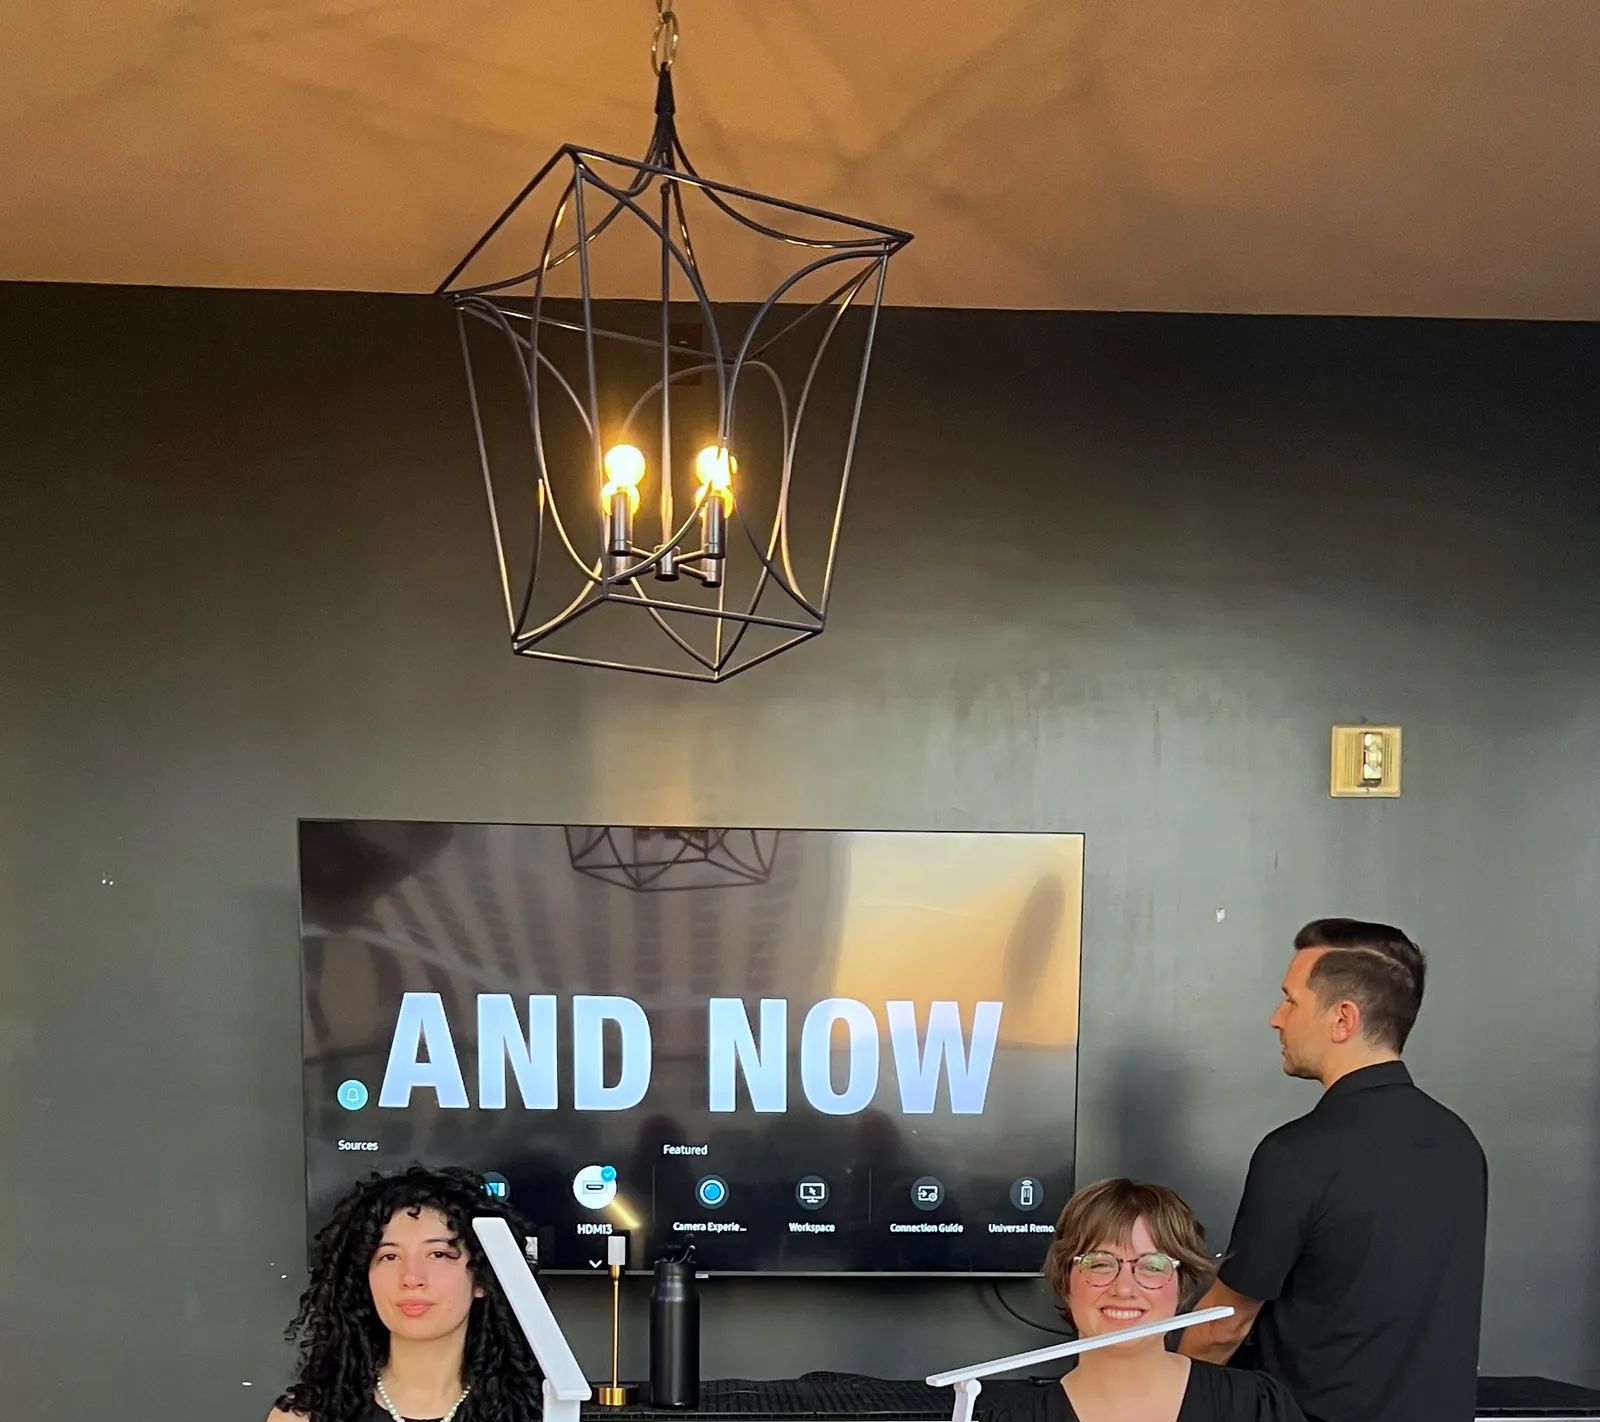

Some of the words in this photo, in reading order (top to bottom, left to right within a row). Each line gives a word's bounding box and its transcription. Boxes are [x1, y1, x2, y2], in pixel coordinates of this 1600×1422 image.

[378, 991, 653, 1111] AND
[708, 997, 1004, 1115] NOW
[337, 1139, 379, 1151] Sources
[662, 1144, 708, 1156] Featured
[576, 1223, 613, 1235] HDMI3
[672, 1222, 706, 1232] Camera
[788, 1222, 836, 1234] Workspace
[889, 1223, 937, 1234] Connection
[938, 1223, 964, 1234] Guide
[988, 1223, 1028, 1234] Universal
